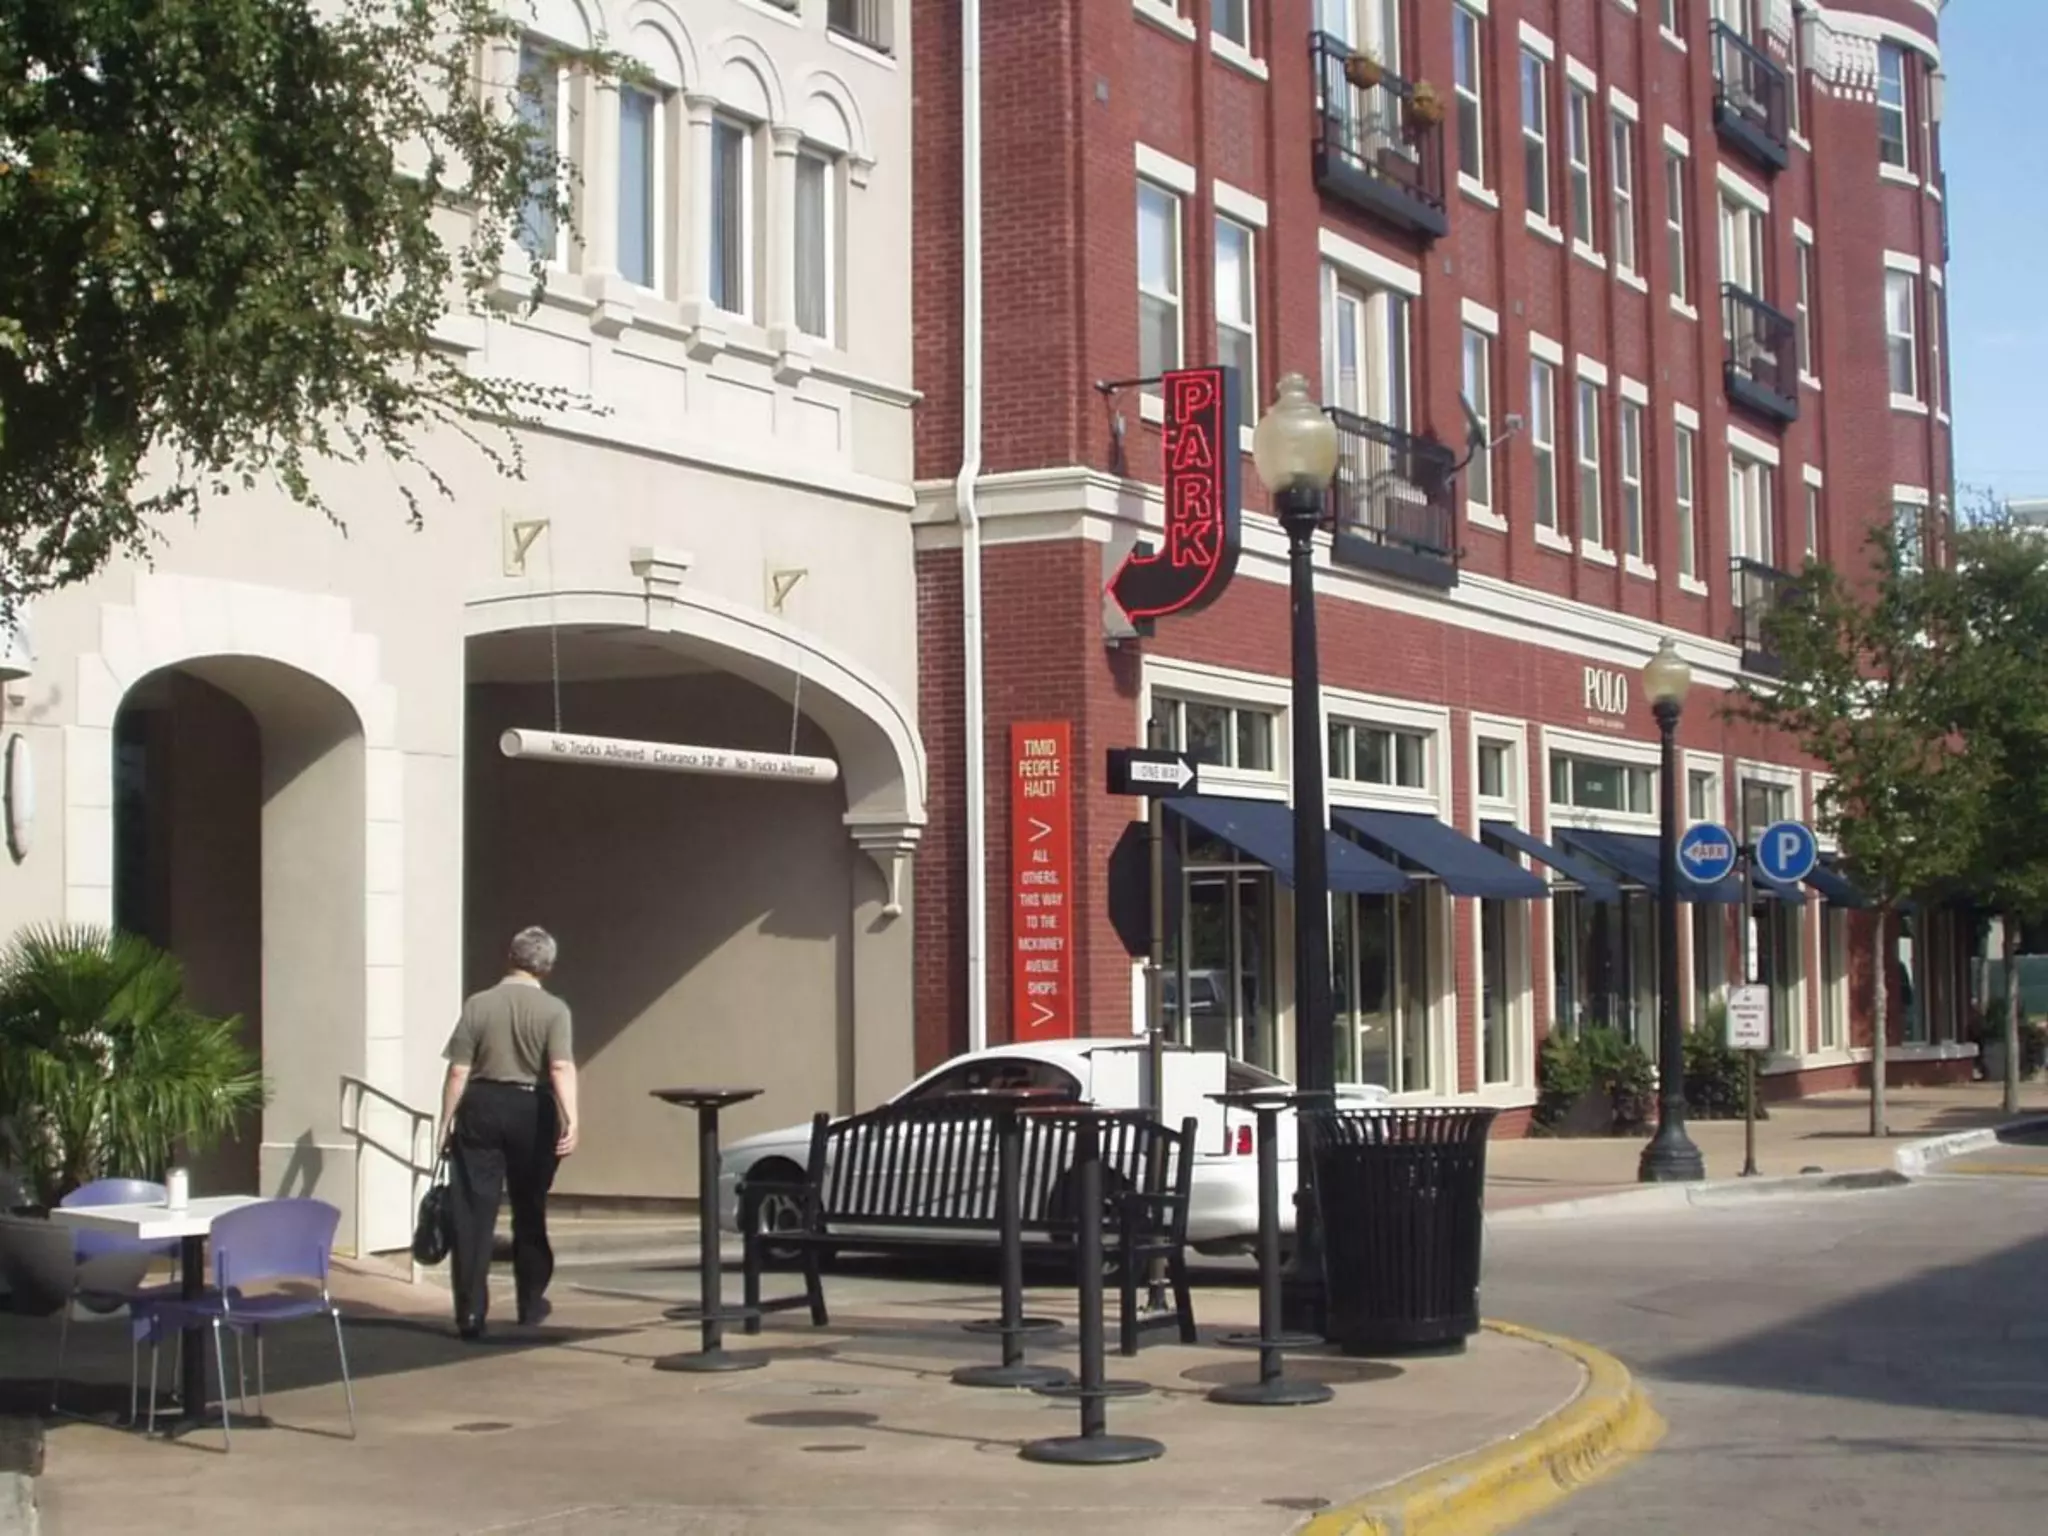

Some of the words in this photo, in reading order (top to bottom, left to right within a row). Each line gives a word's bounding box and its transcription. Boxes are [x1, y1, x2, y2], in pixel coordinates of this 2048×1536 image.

[1172, 378, 1213, 567] PARK
[1584, 666, 1628, 715] POLO
[1024, 739, 1057, 756] TIMID
[551, 740, 565, 753] No
[570, 741, 601, 757] Trucks
[604, 744, 645, 761] Allowed
[654, 750, 698, 766] Clearance
[735, 757, 748, 769] No
[751, 759, 778, 773] Trucks
[781, 761, 815, 776] Allowed
[1019, 759, 1061, 778] PEOPLE
[1140, 765, 1160, 779] ONE
[1161, 766, 1179, 779] WAY
[1024, 779, 1056, 798] HALT!
[1032, 848, 1049, 862] ALL
[1691, 844, 1725, 858] PARK
[1778, 832, 1801, 871] P
[1019, 892, 1040, 906] THIS
[1042, 892, 1063, 906] WAY
[1026, 915, 1038, 928] TO
[1041, 915, 1057, 928] THE
[1027, 981, 1058, 996] SHOPS
